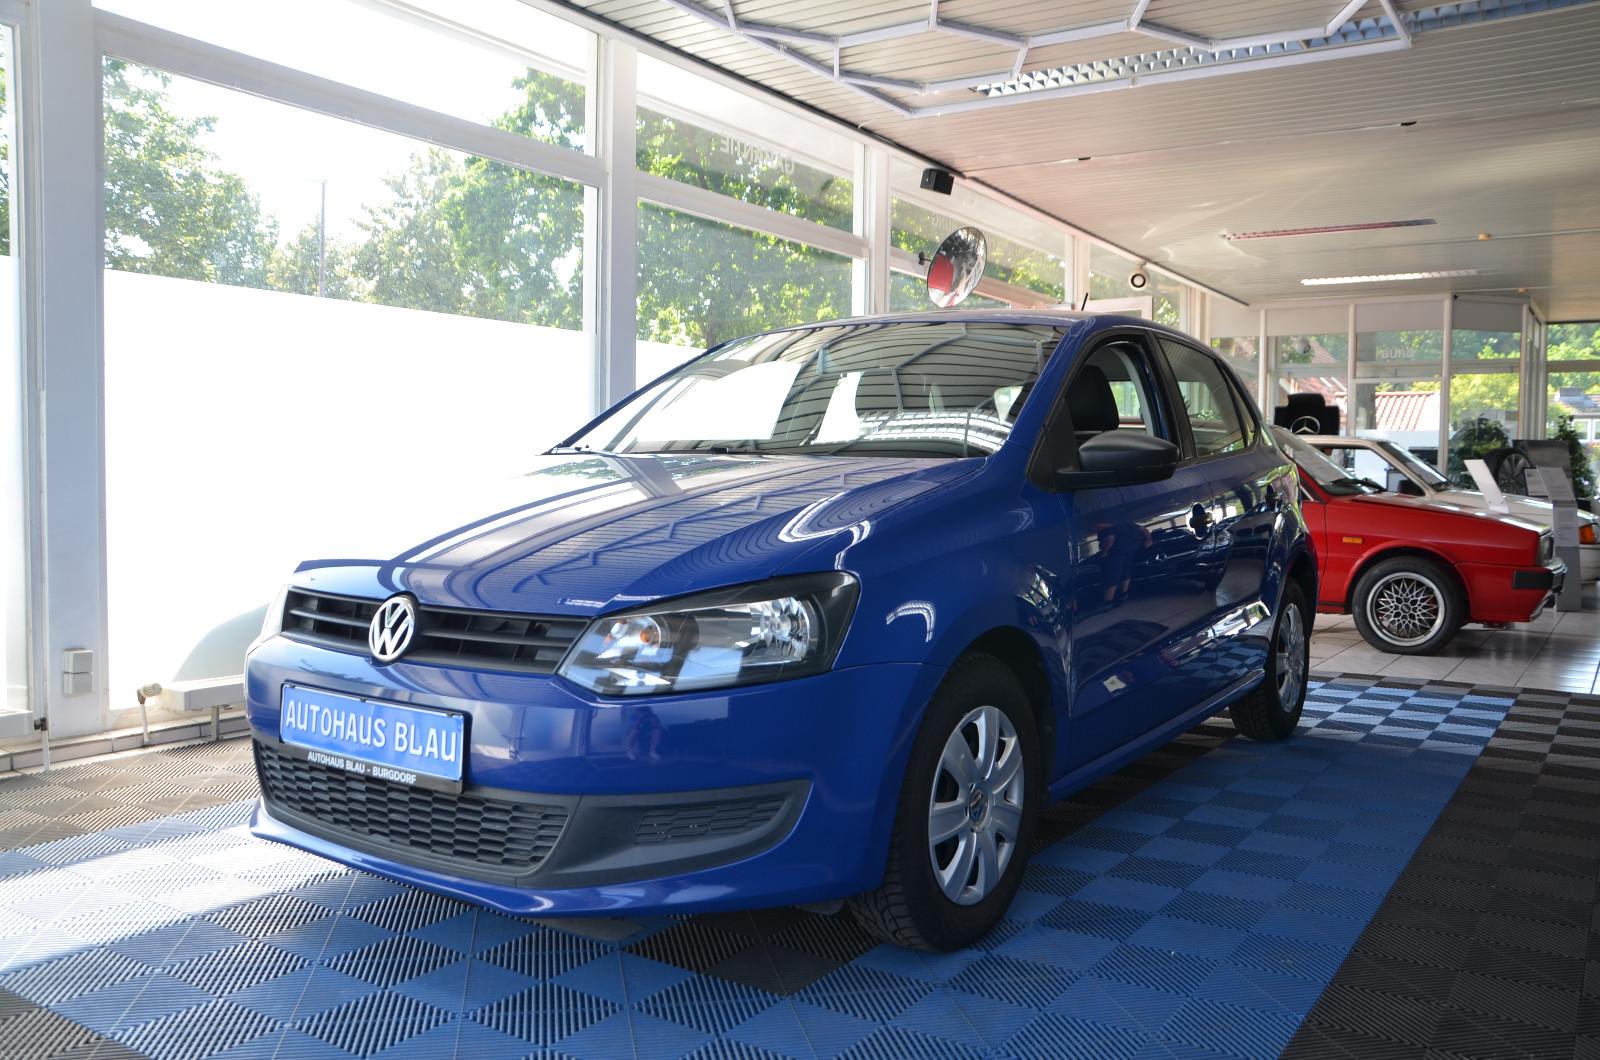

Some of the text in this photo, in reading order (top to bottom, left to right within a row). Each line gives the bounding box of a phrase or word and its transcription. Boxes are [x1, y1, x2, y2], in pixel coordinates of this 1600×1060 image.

[369, 596, 415, 661] VW
[285, 700, 457, 762] AUTOHAUS BLAU
[307, 752, 344, 768] AUTOHAUS
[346, 758, 366, 773] BLAU
[372, 767, 416, 784] BURGDORF
